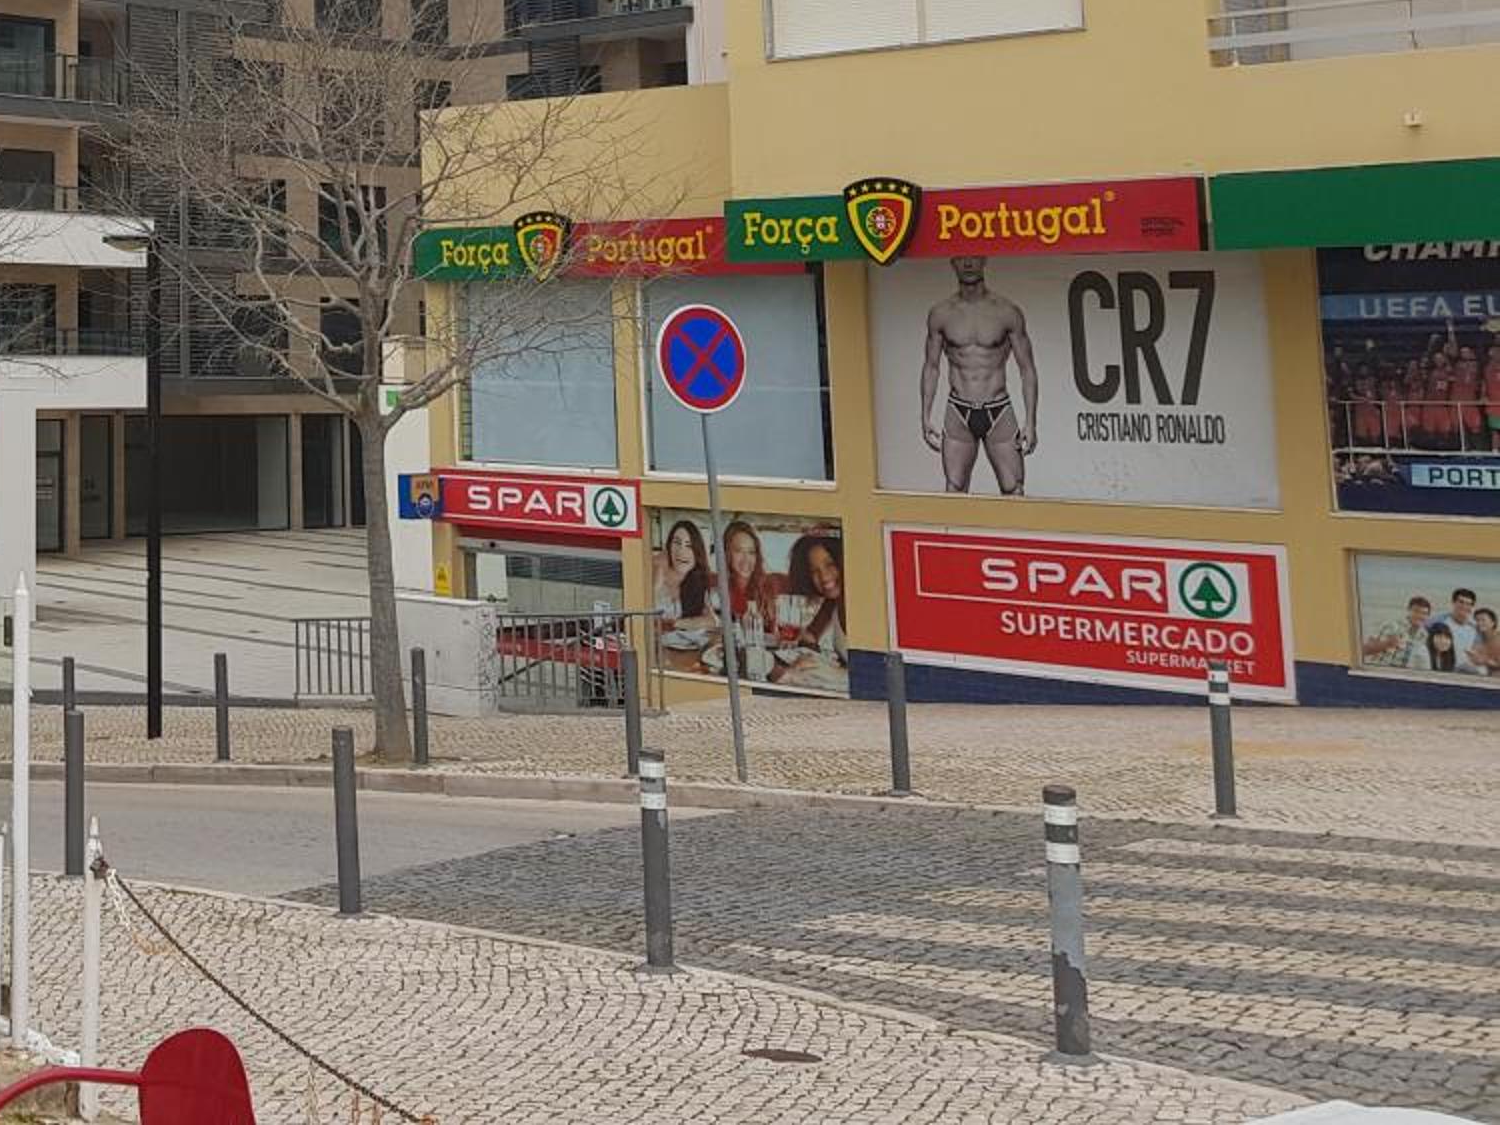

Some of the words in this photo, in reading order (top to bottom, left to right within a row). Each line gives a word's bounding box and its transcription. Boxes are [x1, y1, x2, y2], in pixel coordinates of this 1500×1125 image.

[742, 211, 840, 254] Força
[937, 197, 1107, 244] Portugal
[440, 239, 510, 274] Força
[586, 229, 707, 266] Portugal
[1358, 296, 1451, 319] UEFA
[1067, 270, 1216, 406] CR7
[1077, 412, 1150, 443] CRISTIANO
[1156, 413, 1226, 444] RONALDO
[1428, 467, 1500, 487] PORT
[467, 485, 583, 516] SPAR
[981, 558, 1164, 604] SPAR
[1001, 610, 1255, 656] SUPERMERCADO
[1126, 650, 1255, 675] SUPERMAET
